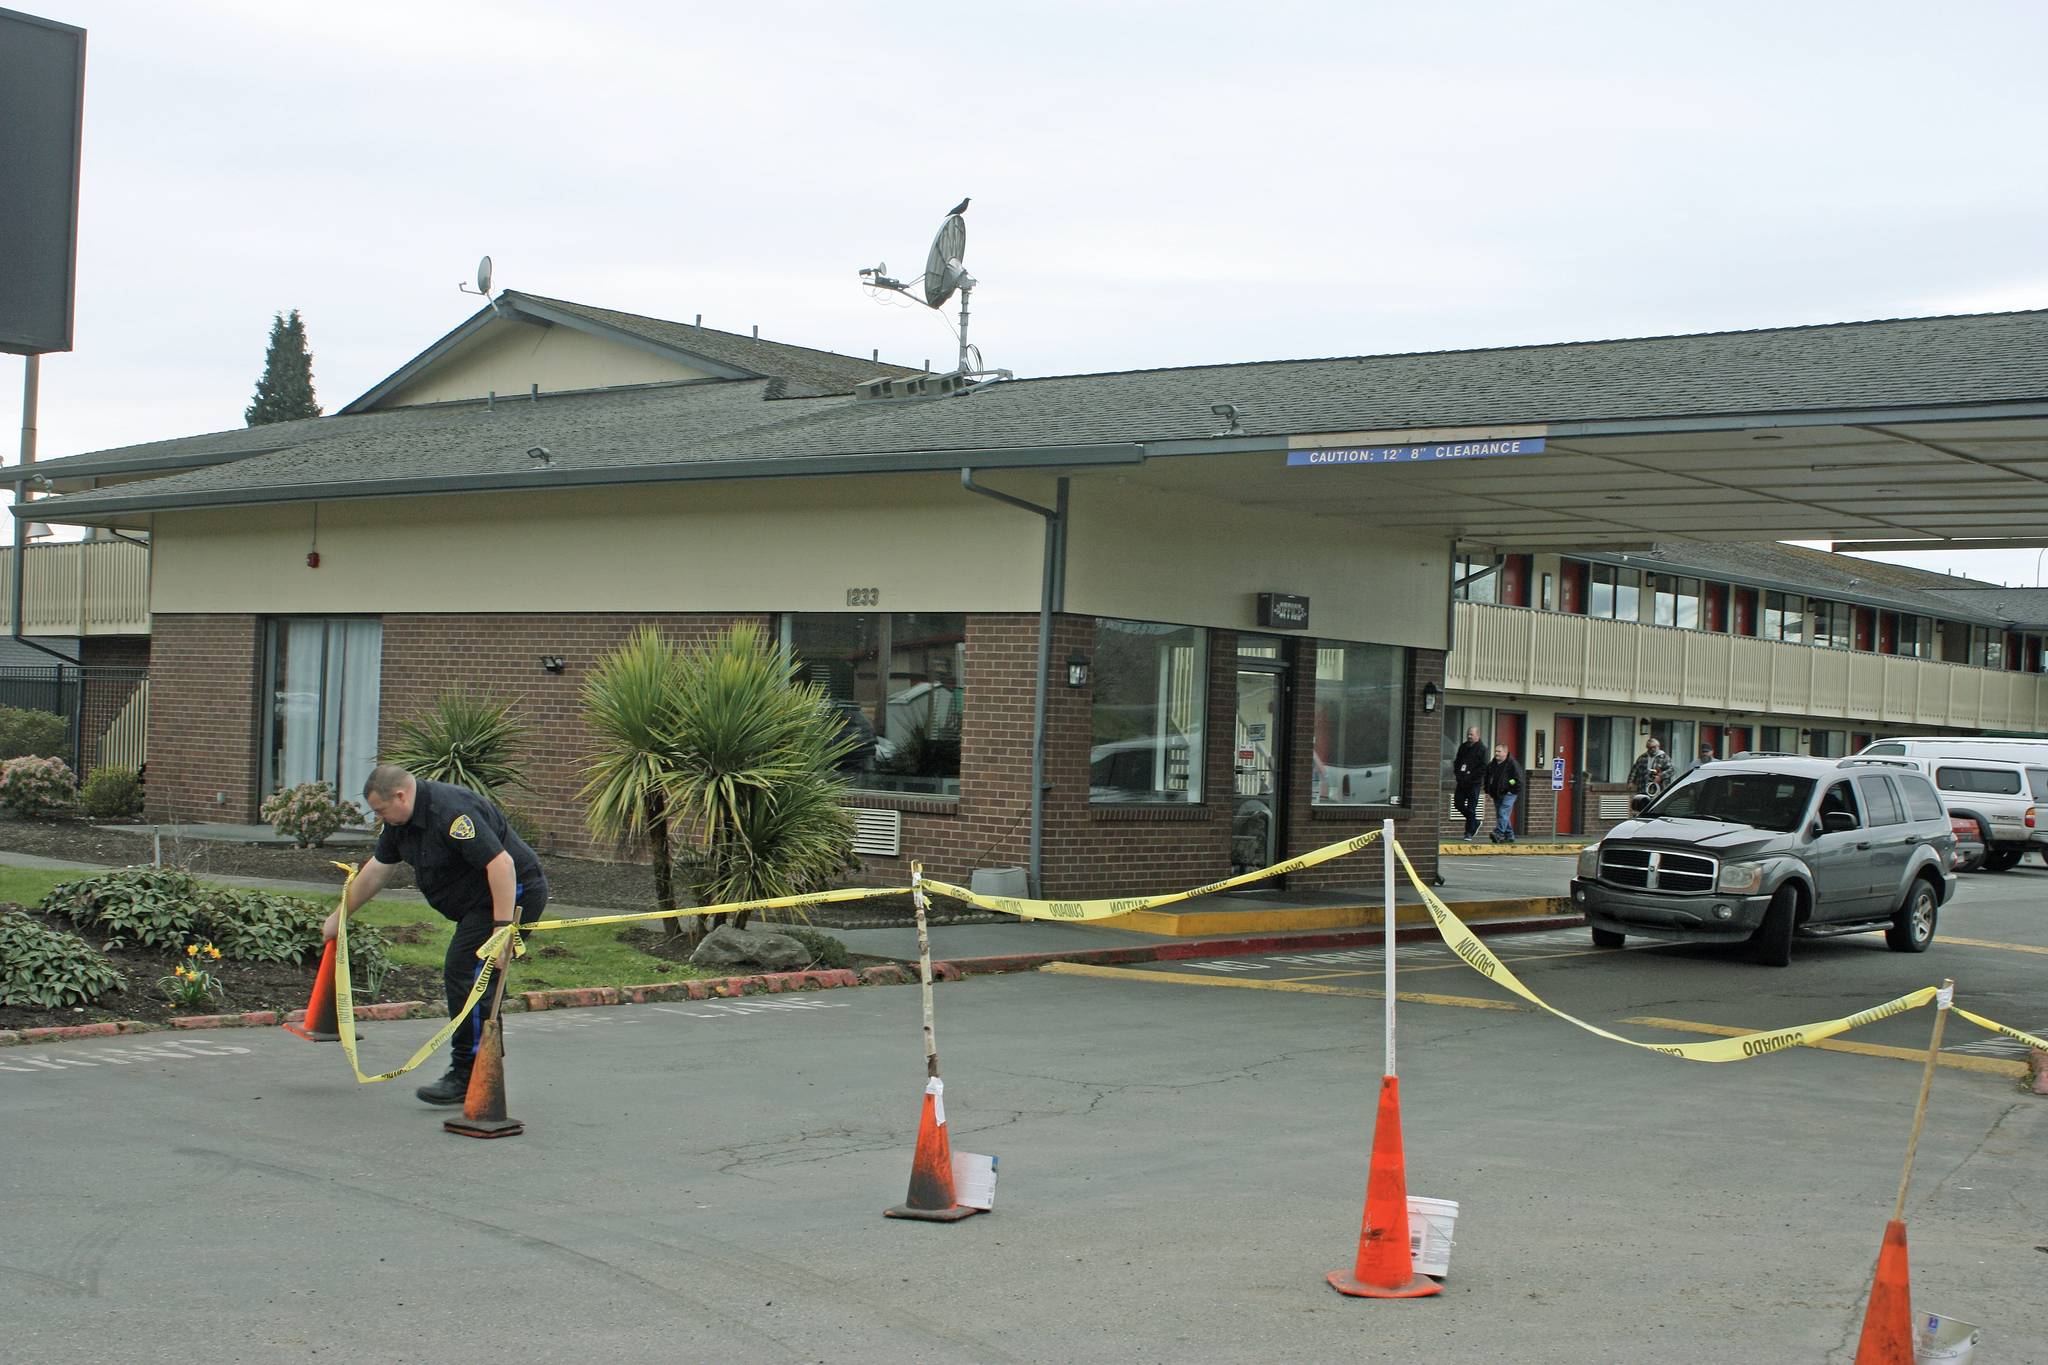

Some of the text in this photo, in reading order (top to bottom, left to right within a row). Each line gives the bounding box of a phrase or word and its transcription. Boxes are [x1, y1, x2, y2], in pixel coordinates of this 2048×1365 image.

[1310, 451, 1374, 463] CAUTION:
[1435, 441, 1521, 458] CLEARANCE
[847, 588, 879, 606] 1233
[1455, 936, 1496, 978] CAUTION
[476, 956, 498, 993] CAUTION
